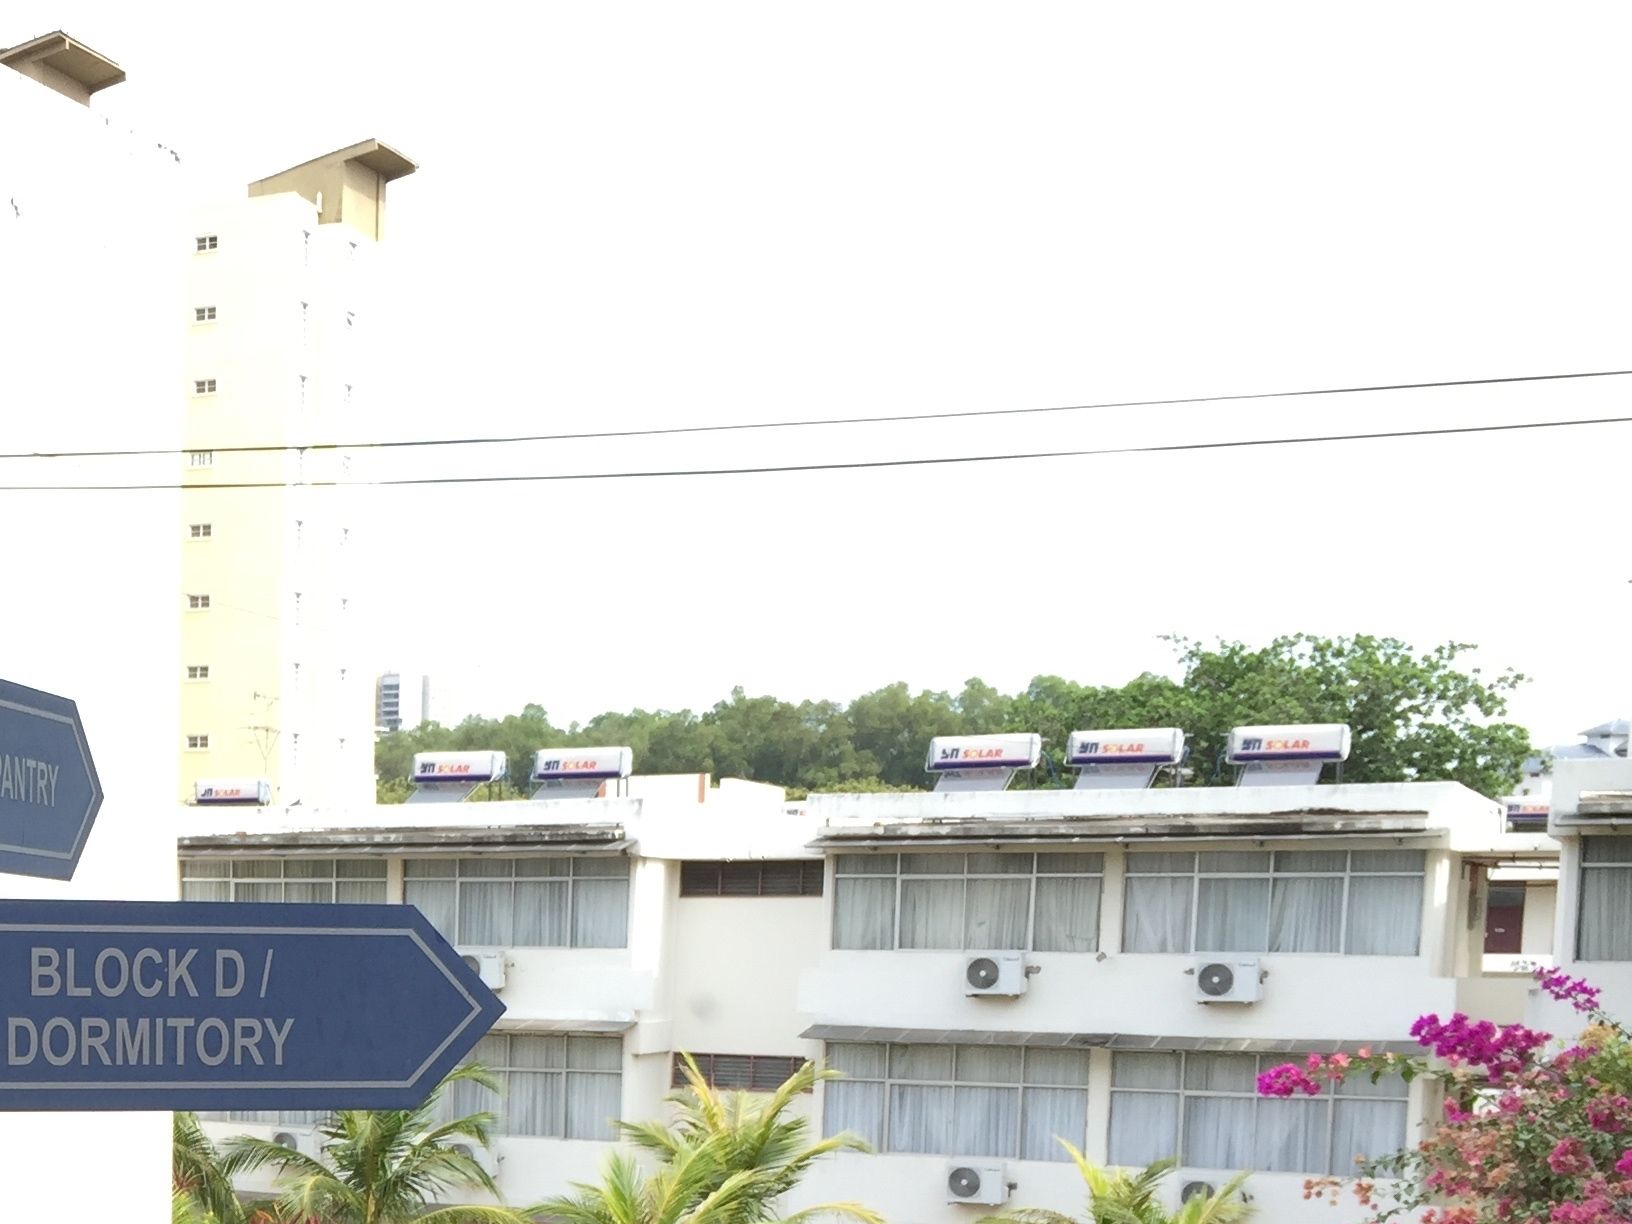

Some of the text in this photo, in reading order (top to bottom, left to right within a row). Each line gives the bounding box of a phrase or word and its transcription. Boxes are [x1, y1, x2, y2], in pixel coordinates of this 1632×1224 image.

[30, 946, 199, 998] BLOCK
[215, 948, 246, 998] D
[7, 1016, 295, 1067] DORMITORY
